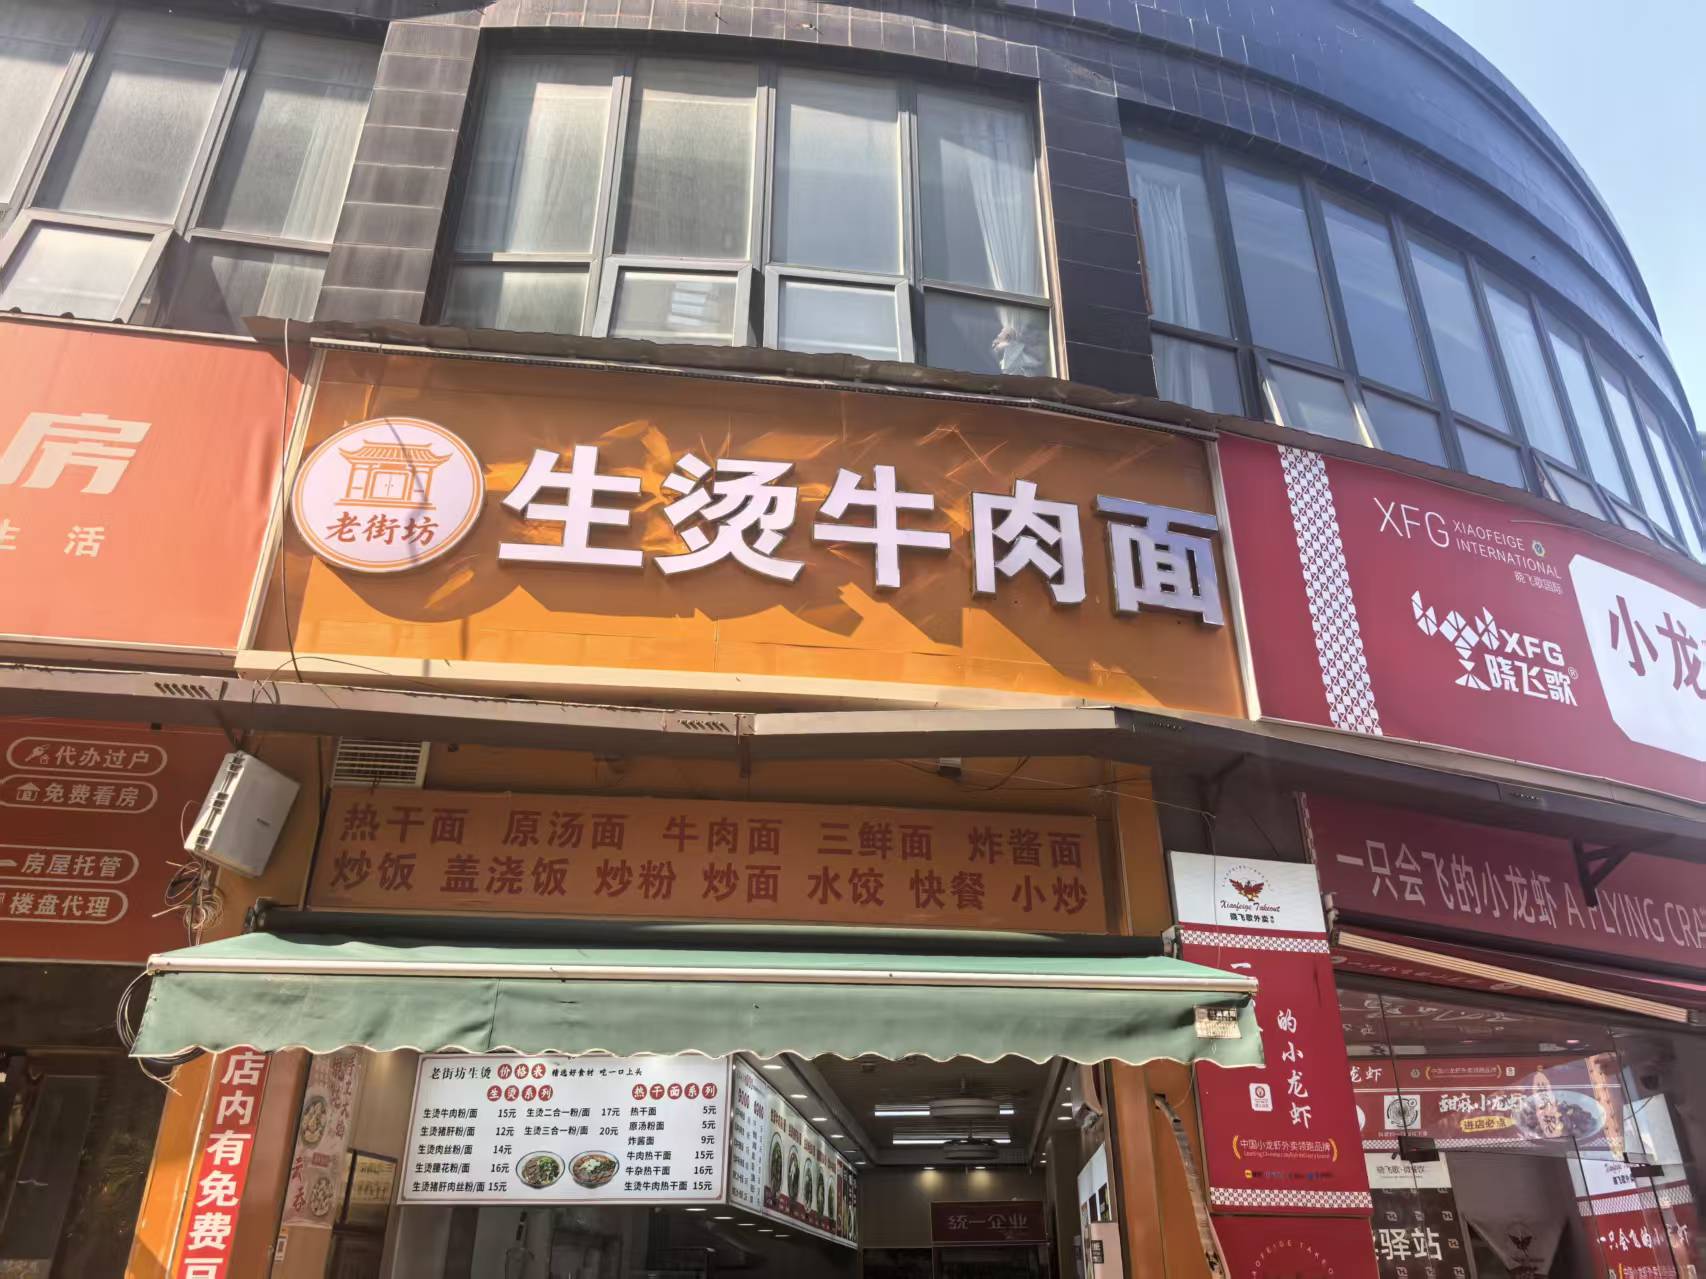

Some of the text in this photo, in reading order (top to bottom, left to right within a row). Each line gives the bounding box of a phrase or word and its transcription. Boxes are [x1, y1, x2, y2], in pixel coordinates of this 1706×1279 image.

[0, 412, 152, 494] 房
[325, 511, 439, 545] 老街坊
[1374, 497, 1449, 548] XFG
[499, 444, 1225, 627] 生烫牛肉面
[1452, 519, 1525, 551] XIAOFEIGE
[1456, 538, 1562, 580] INTERNATIONAL
[1499, 628, 1565, 667] XFG
[55, 745, 150, 770] 代办过户
[43, 782, 140, 808] 免费看房
[339, 802, 1083, 870] 热干面 原汤面 牛肉面 三鲜面 炸酱面
[21, 852, 122, 878] 房屋托管
[329, 850, 1089, 915] 炒饭 盖浇饭 炒粉 炒面 水饺 快餐 小炒
[1336, 838, 1559, 930] 一只会飞的小龙虾
[10, 892, 110, 917] 楼盘代理
[431, 1066, 492, 1080] 老街坊生烫
[423, 1108, 517, 1119] 生烫牛肉粉/面 15元
[526, 1107, 621, 1118] 生烫二合一粉/面 17元
[630, 1106, 717, 1116] 热干面 5元
[420, 1126, 515, 1137] 生烫猪肝粉/面 12元
[524, 1126, 619, 1136] 生烫三合一粉/面 20元
[628, 1121, 716, 1131] 原汤粉面 5元
[493, 1145, 512, 1154] 14元
[627, 1135, 715, 1146] 炸酱面 9元
[626, 1150, 714, 1161] 牛肉热干面 15元
[490, 1163, 510, 1173] 16元
[625, 1165, 713, 1176] 牛杂热干面 16元
[488, 1182, 507, 1192] 15元
[624, 1181, 712, 1191] 生烫牛肉热干面 15元
[948, 1212, 1030, 1230] 统一企业
[1373, 1227, 1443, 1261] 驿站
